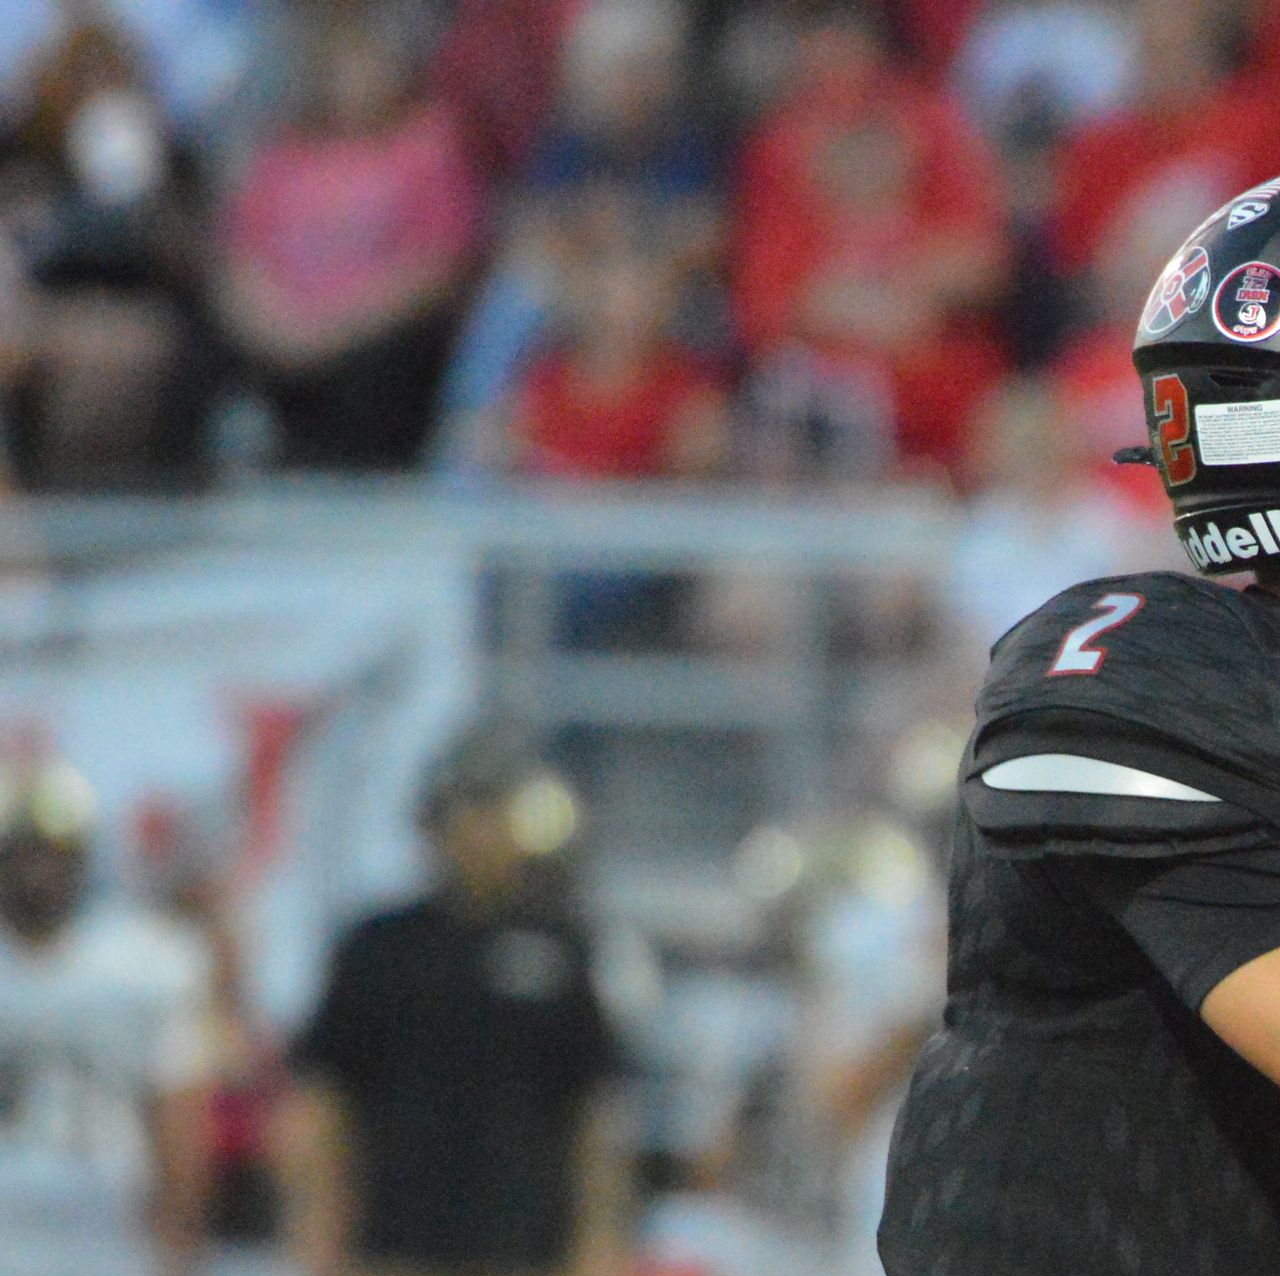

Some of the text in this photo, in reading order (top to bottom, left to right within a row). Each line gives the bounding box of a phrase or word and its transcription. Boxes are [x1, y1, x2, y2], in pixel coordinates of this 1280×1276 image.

[1152, 373, 1197, 487] 2
[1227, 404, 1263, 413] WARNING
[1047, 592, 1145, 676] 2
